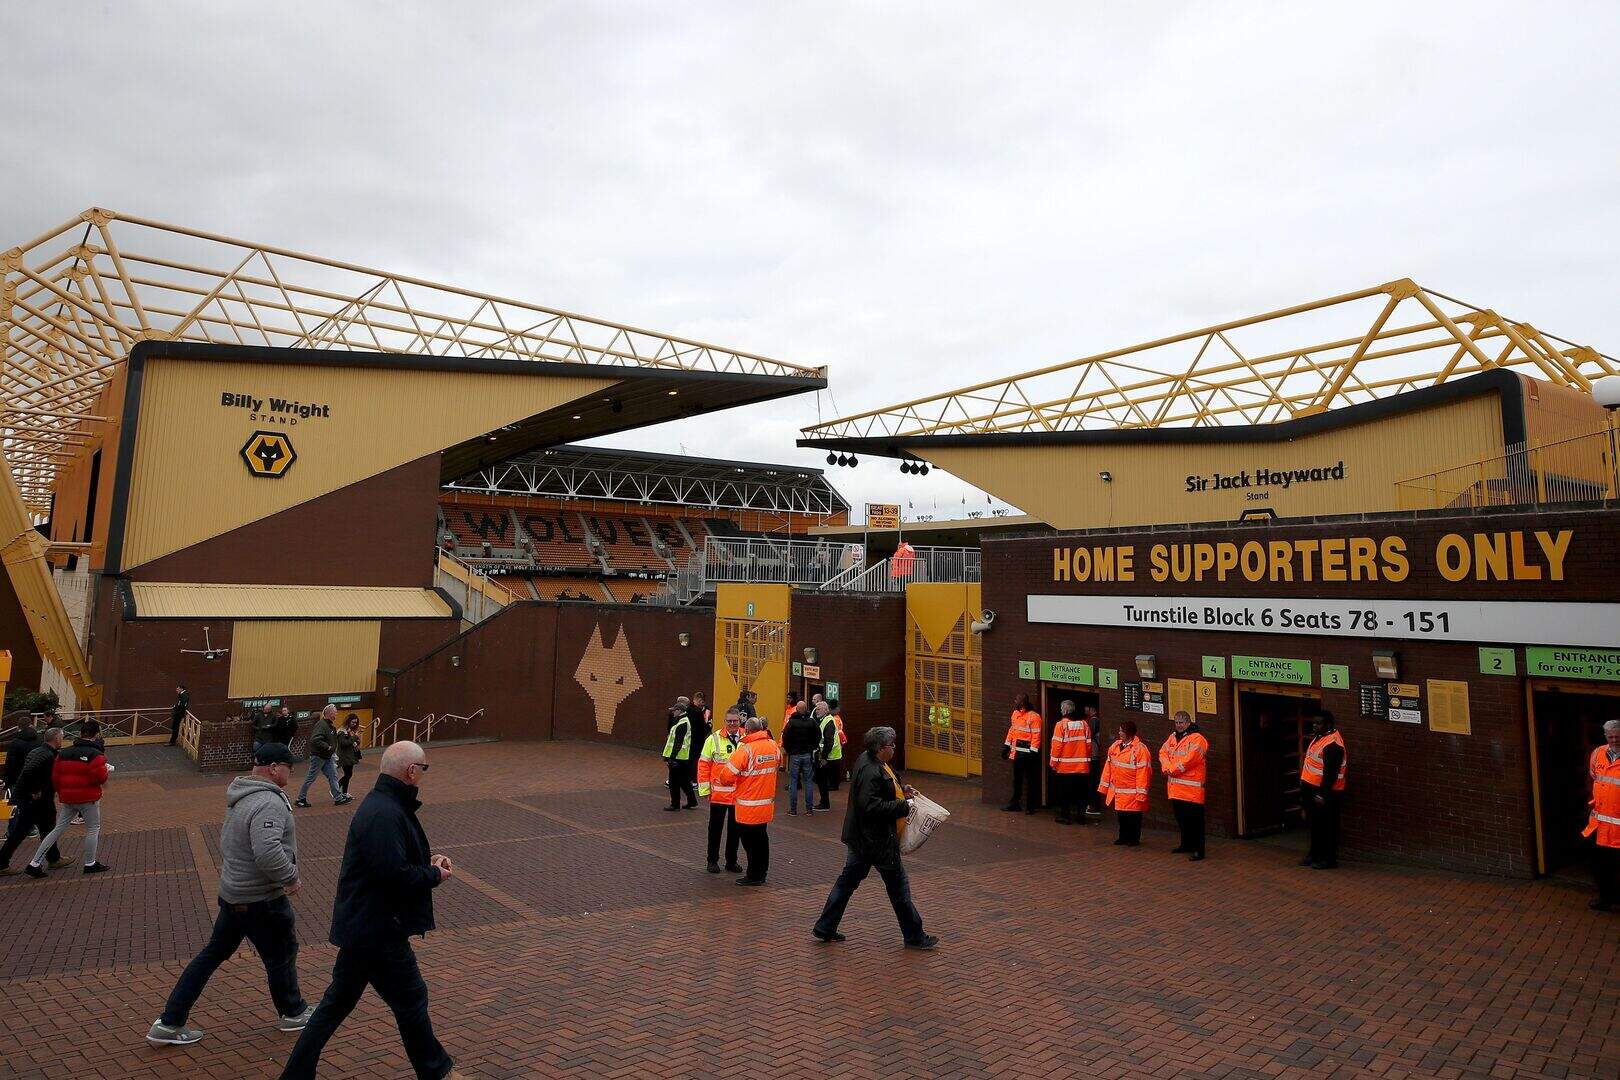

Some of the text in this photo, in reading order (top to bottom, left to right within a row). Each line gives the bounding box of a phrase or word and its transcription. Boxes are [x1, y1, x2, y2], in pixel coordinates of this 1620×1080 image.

[221, 392, 330, 419] Billy Wright
[250, 413, 298, 426] STAND
[1185, 461, 1344, 492] Sir Jack Hayward
[1246, 491, 1269, 501] Stand
[463, 510, 685, 547] WOLVES
[1053, 530, 1574, 582] HOME SUPPORTERS ONLY
[1123, 605, 1198, 625] Turnstile
[1203, 607, 1255, 627] Block
[1261, 608, 1274, 627] 6
[1280, 608, 1342, 630] Seats
[1349, 610, 1379, 631] 78
[1403, 611, 1450, 633] 151
[1493, 659, 1502, 670] 2
[1554, 652, 1620, 664] ENTRANCE
[1024, 667, 1030, 676] 6
[1051, 664, 1080, 674] ENTRANCE
[1210, 664, 1217, 674] 4
[1248, 660, 1292, 670] ENTRANCE
[1537, 662, 1555, 671] for
[1558, 665, 1584, 674] over
[1588, 665, 1613, 676] 17's
[1105, 676, 1111, 685] 5
[1238, 667, 1304, 682] for over 17's only
[1331, 673, 1339, 684] 3
[827, 683, 838, 698] PP
[870, 684, 878, 698] P
